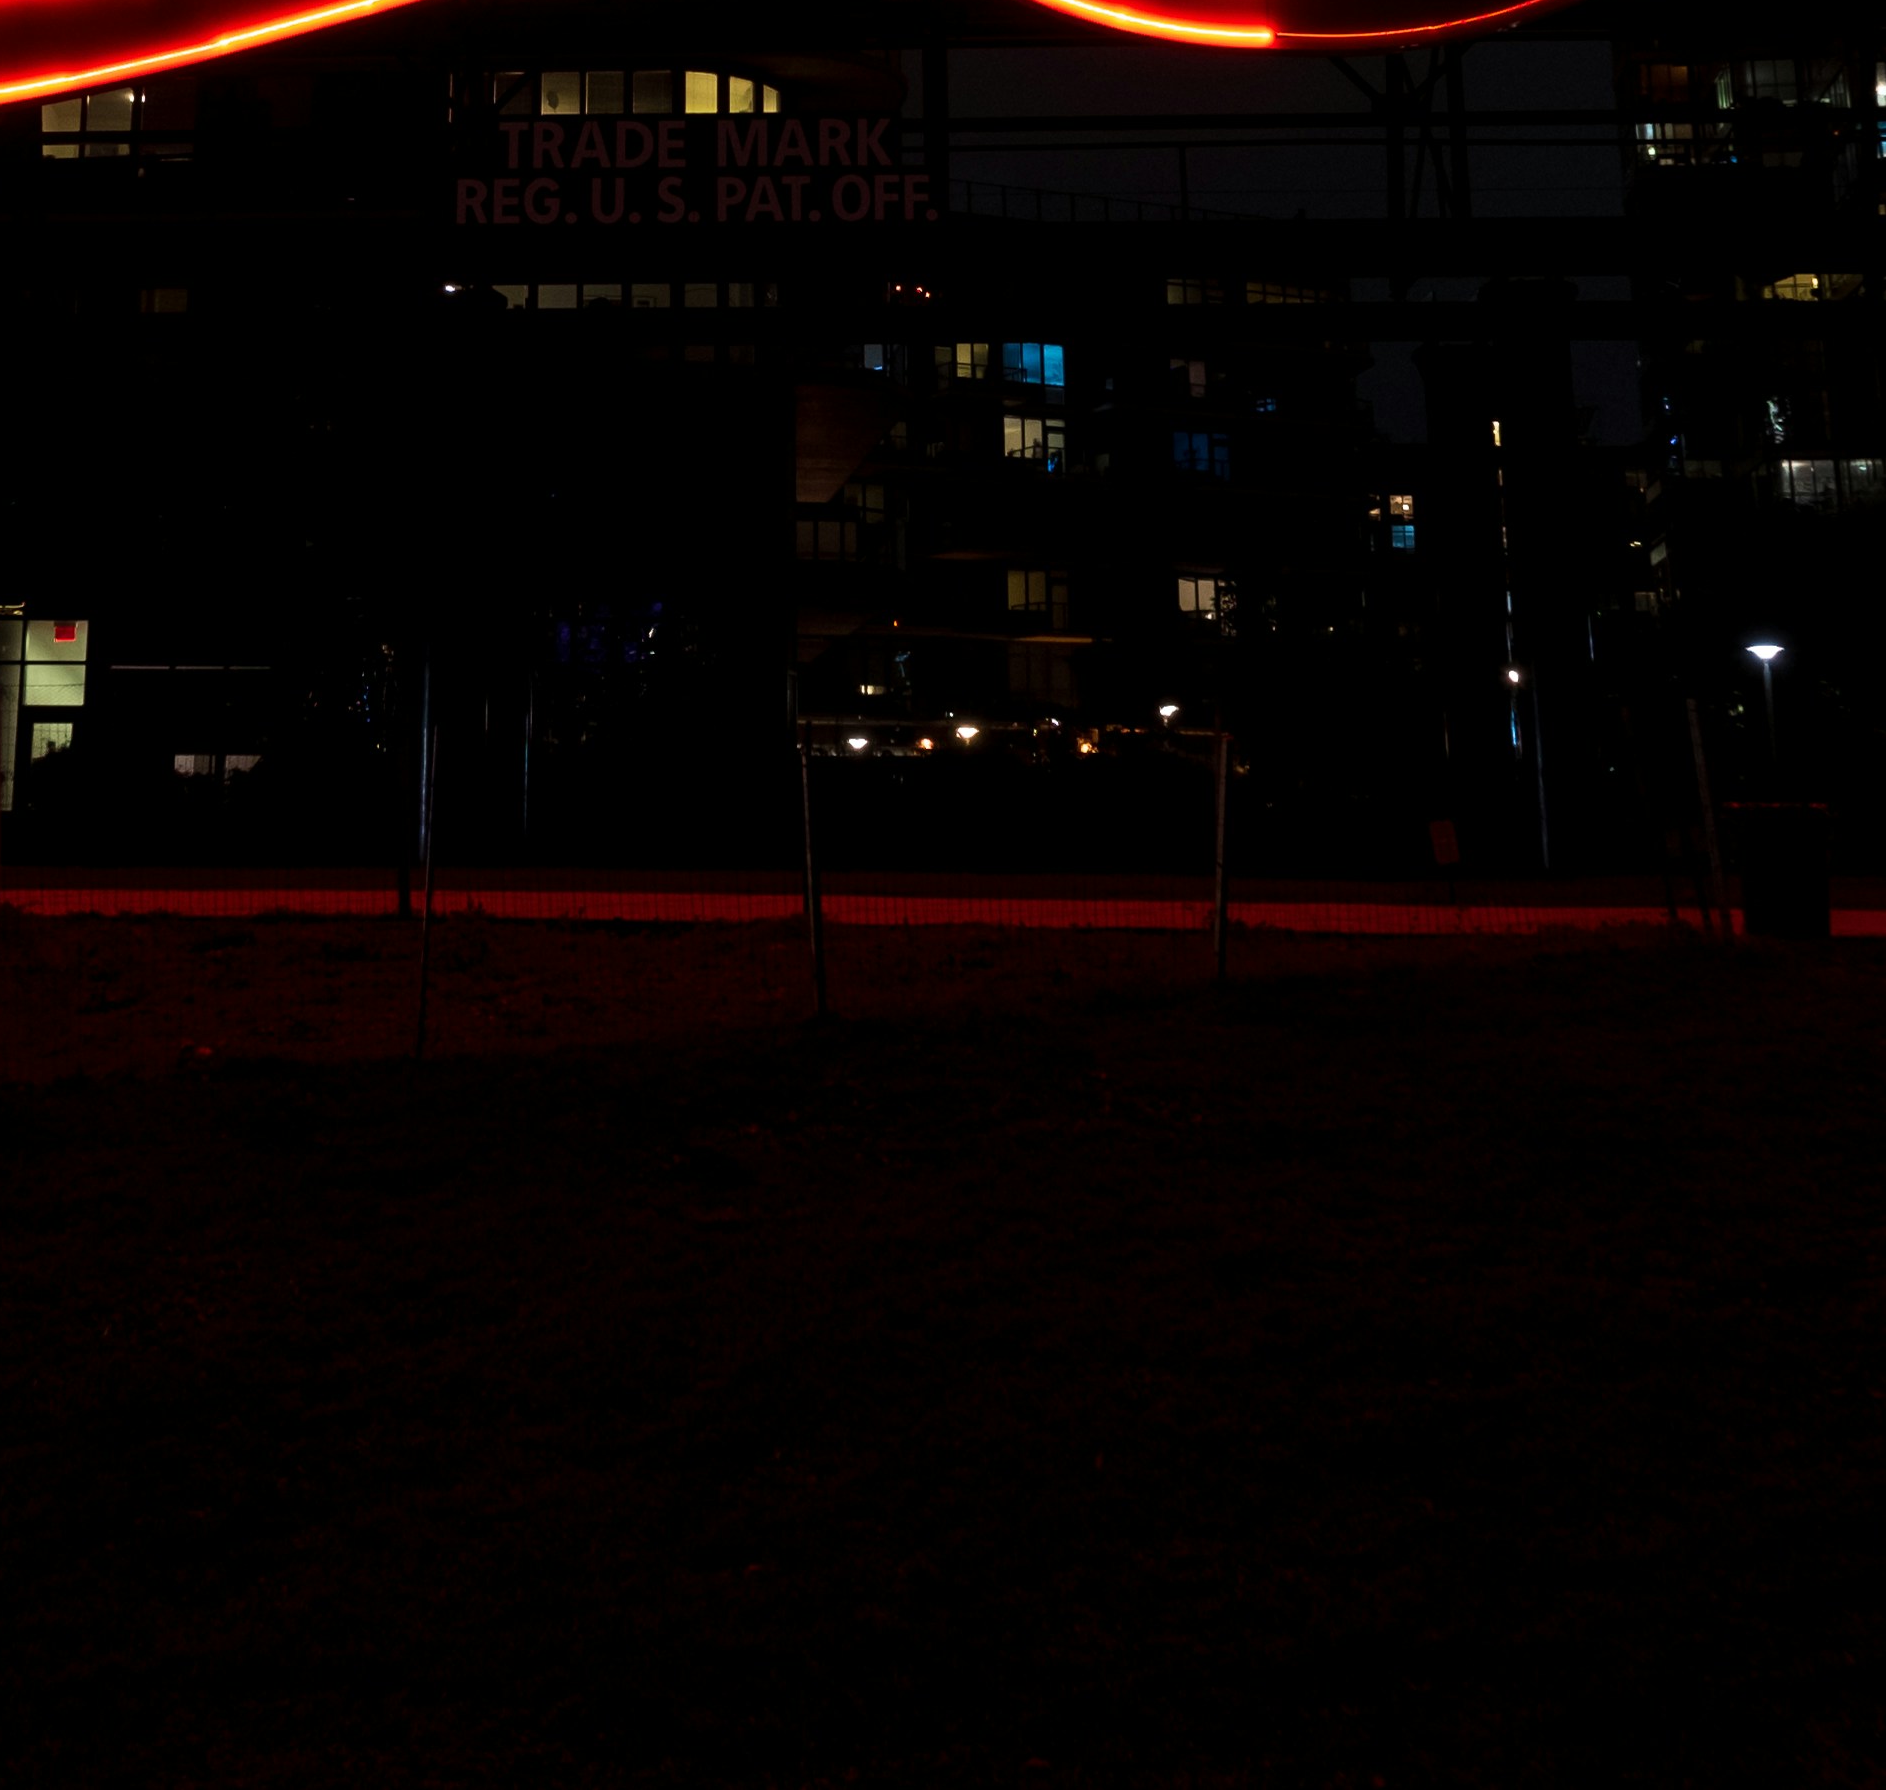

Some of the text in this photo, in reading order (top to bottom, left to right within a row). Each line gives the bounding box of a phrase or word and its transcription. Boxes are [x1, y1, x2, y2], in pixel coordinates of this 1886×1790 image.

[499, 118, 893, 169] TRADE MARK
[455, 177, 578, 225] REG.
